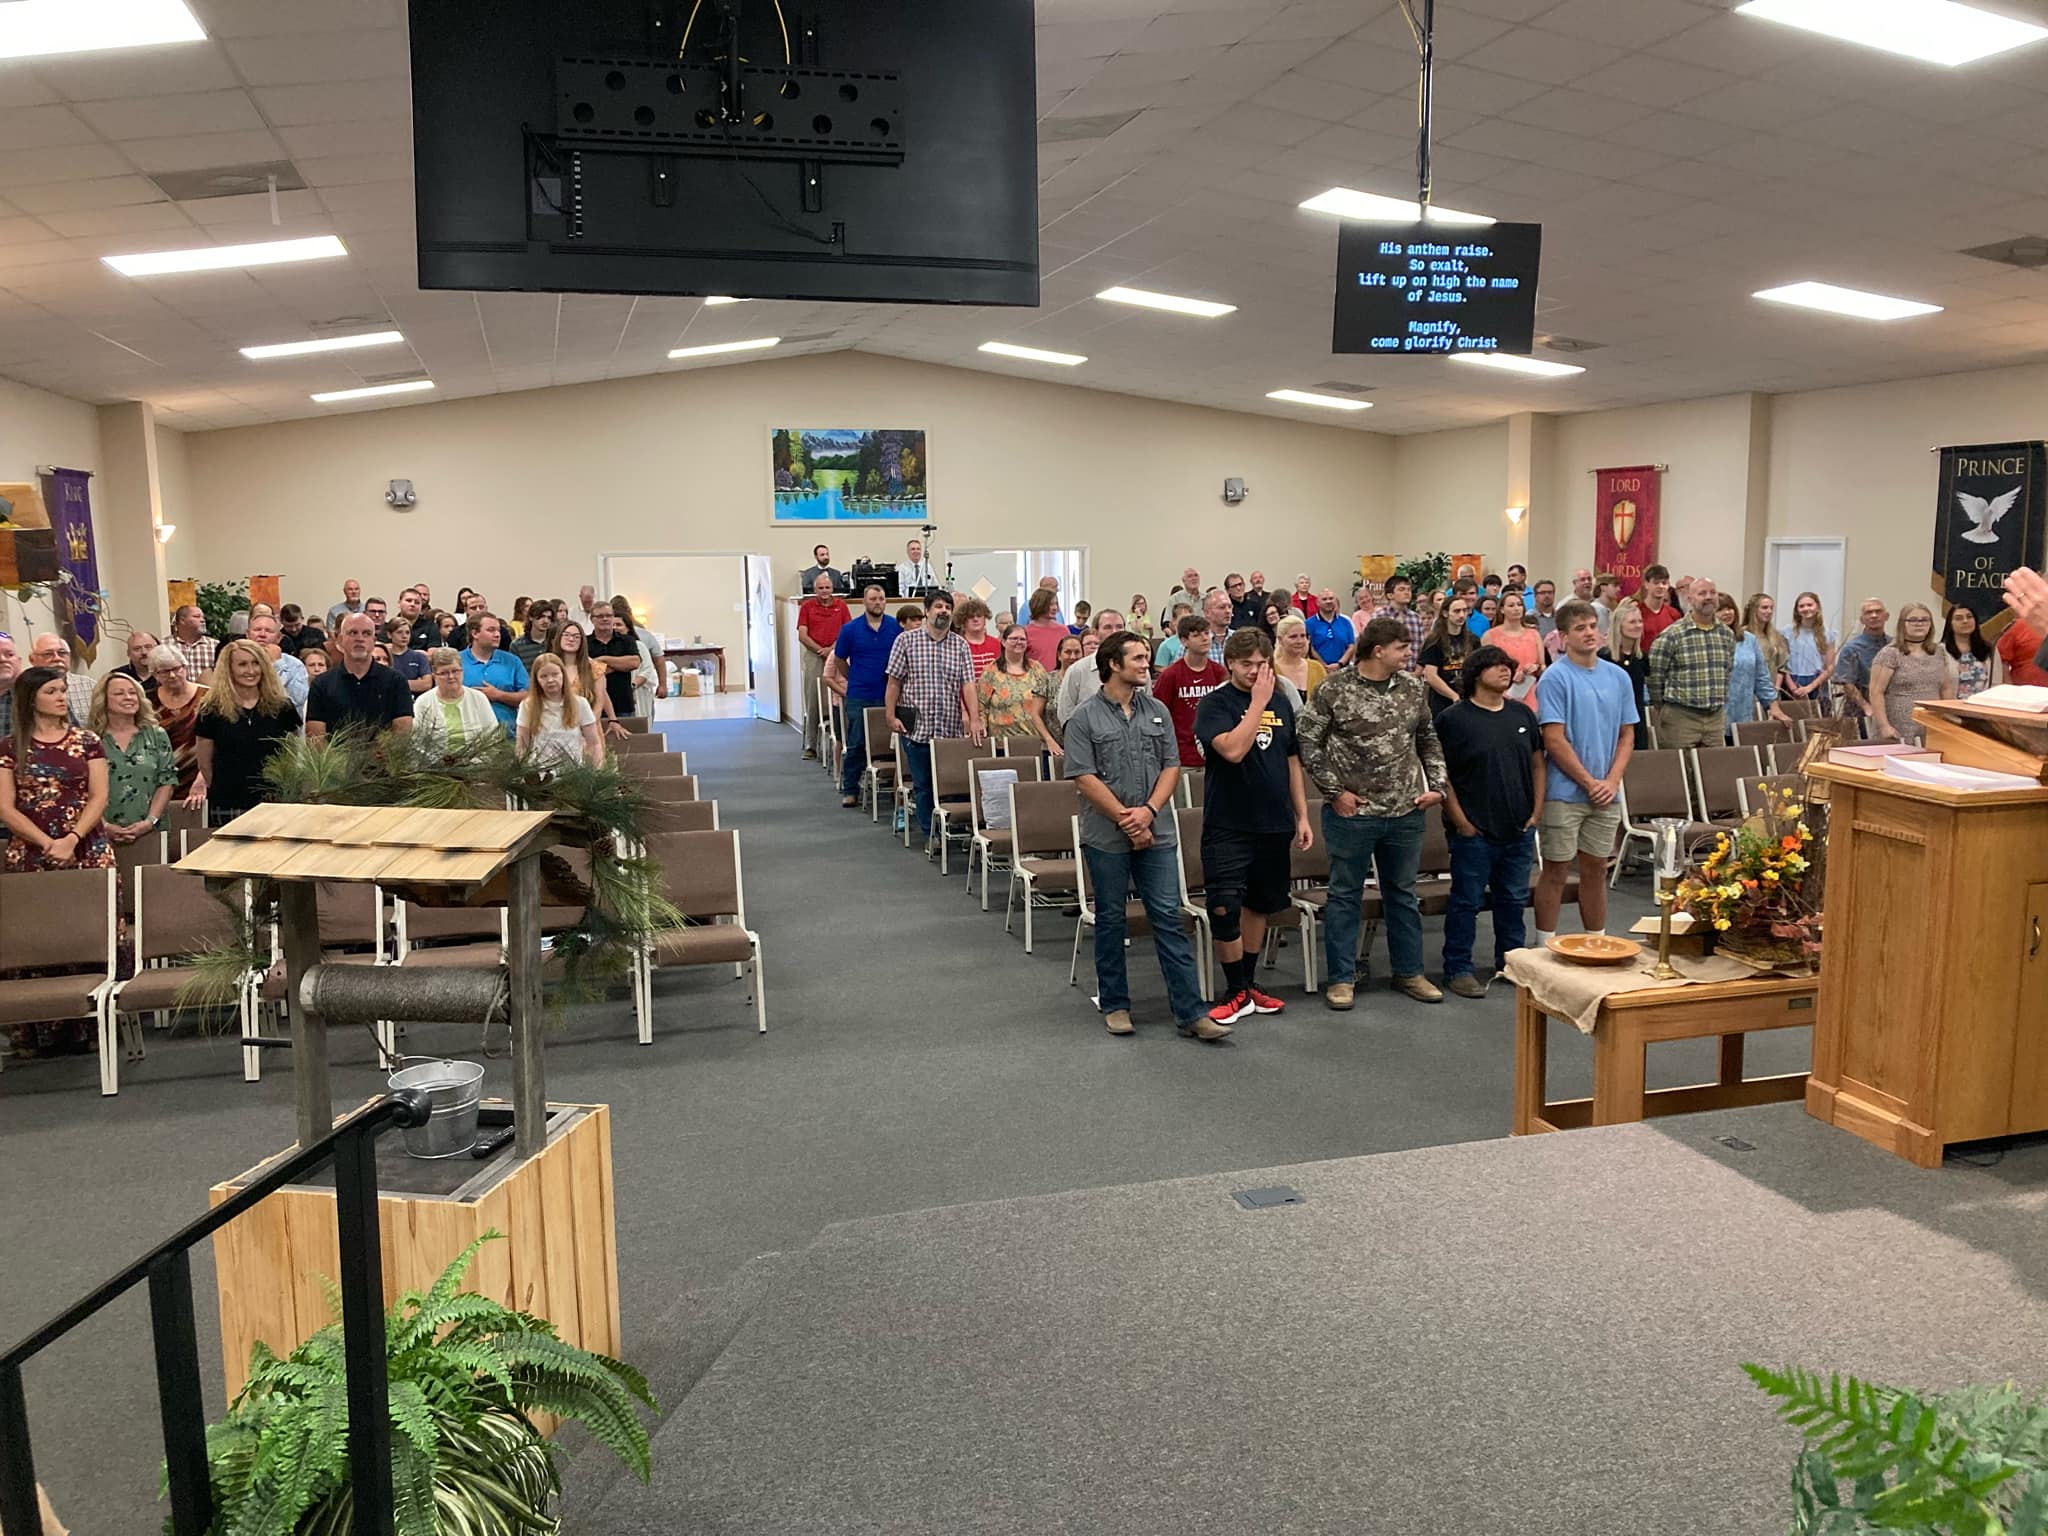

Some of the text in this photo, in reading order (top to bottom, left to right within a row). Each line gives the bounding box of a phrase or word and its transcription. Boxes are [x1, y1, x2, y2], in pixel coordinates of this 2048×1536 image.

[1379, 242, 1494, 257] His anthem raise.
[1408, 259, 1470, 273] So exalt,
[1358, 272, 1520, 289] lift up on high the name
[1407, 290, 1468, 303] of Jesus.
[1408, 320, 1462, 335] Magnify,
[1371, 337, 1498, 351] come glorify Christ
[1957, 457, 2025, 477] PRINCE
[1611, 478, 1640, 492] LORD
[1616, 552, 1628, 563] OF
[1974, 556, 1995, 570] OF
[1178, 685, 1218, 698] ALABAM
